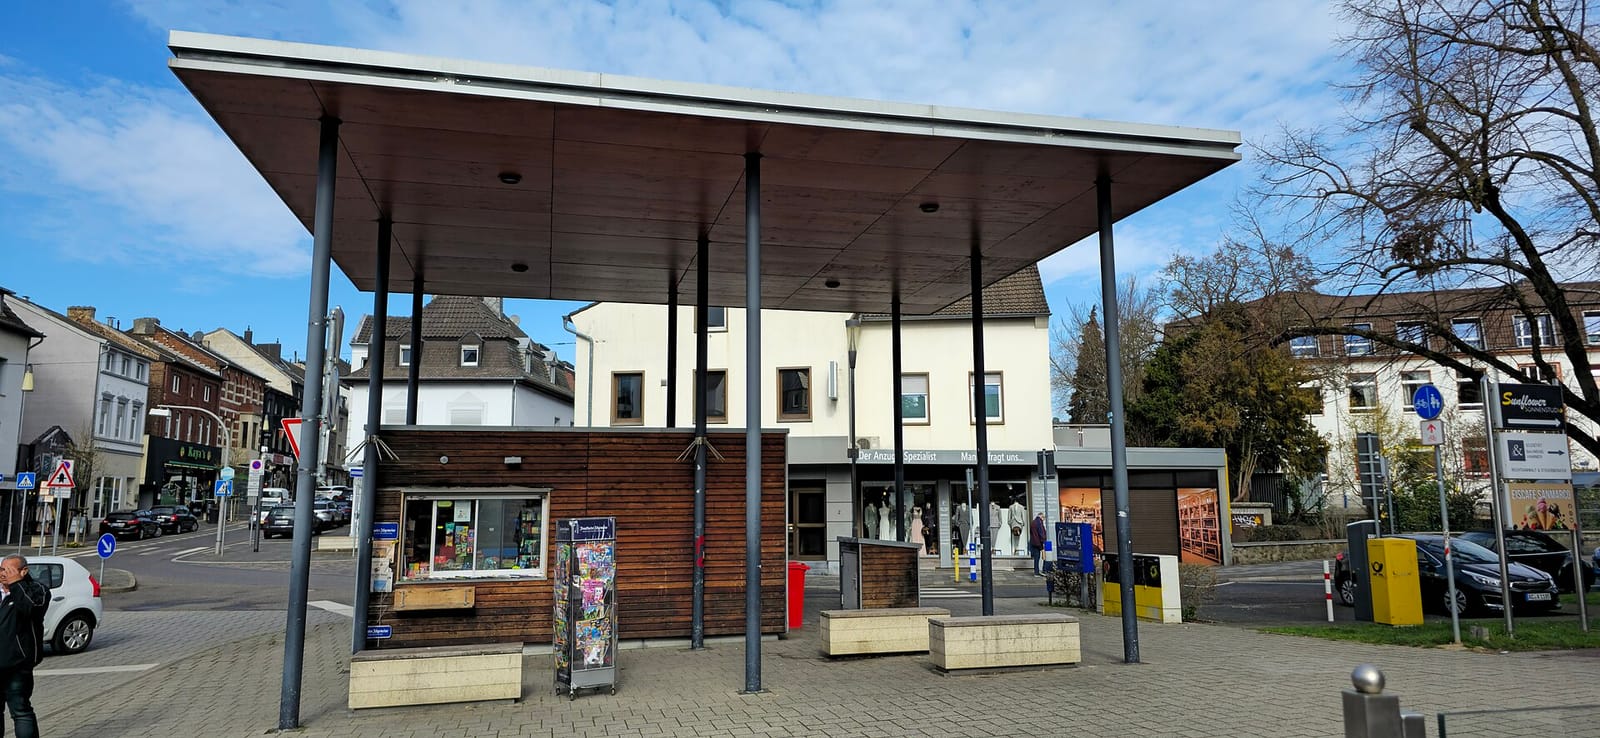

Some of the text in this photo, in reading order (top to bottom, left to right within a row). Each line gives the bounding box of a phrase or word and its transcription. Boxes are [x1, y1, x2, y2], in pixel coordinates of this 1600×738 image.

[1502, 391, 1547, 410] Sunflower
[858, 450, 871, 460] Der
[903, 451, 937, 463] Spezialist
[961, 452, 977, 461] Man
[987, 452, 1005, 464] fragt
